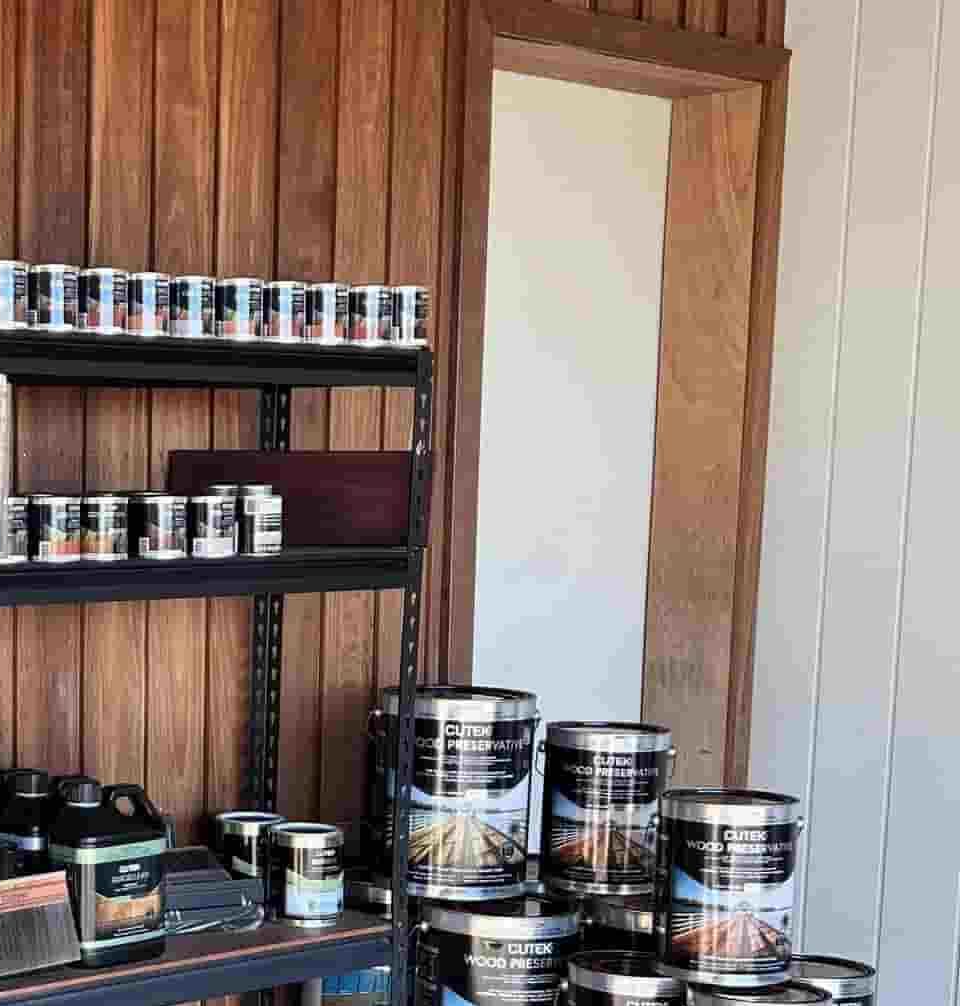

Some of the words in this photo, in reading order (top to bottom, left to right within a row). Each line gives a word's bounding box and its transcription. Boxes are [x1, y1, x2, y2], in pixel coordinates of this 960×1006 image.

[445, 723, 494, 738] CUTEK
[415, 736, 443, 750] OOD
[593, 755, 633, 768] CUTEK
[723, 829, 768, 842] CUTEK
[686, 840, 725, 853] WOOD
[507, 942, 553, 955] CUTEK
[464, 953, 507, 970] WOOD
